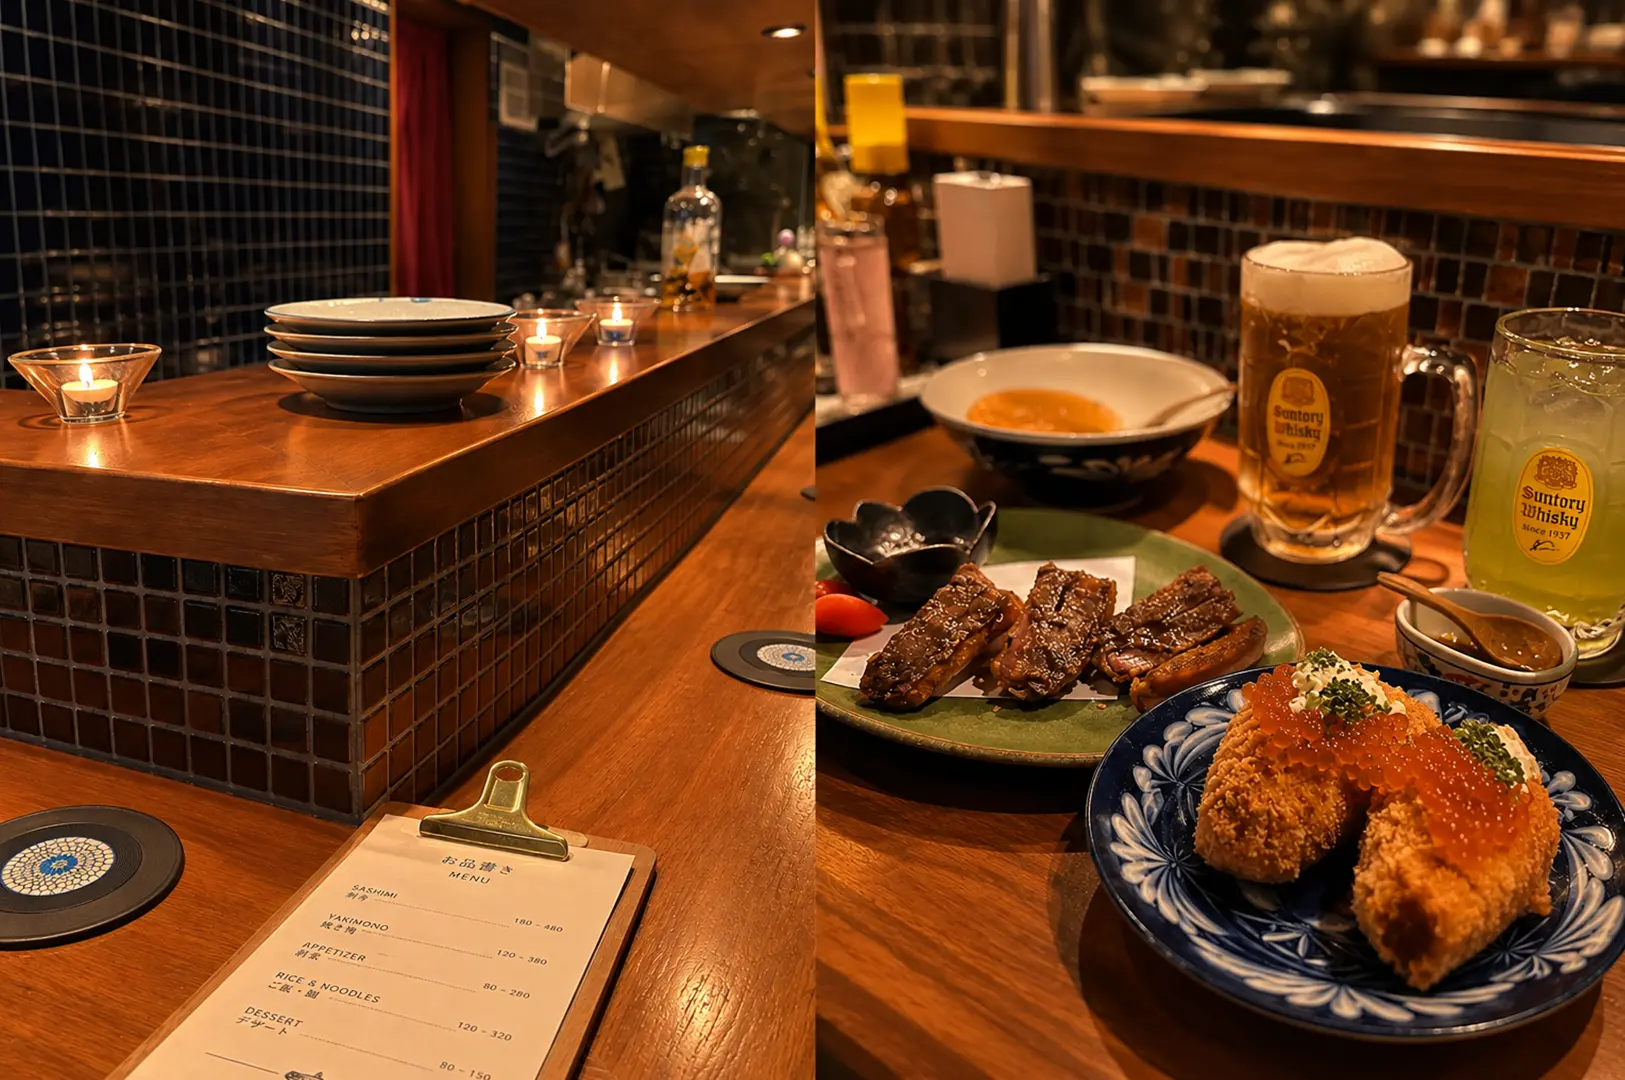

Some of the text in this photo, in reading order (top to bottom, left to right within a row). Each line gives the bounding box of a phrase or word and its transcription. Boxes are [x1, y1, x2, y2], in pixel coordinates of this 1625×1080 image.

[1274, 404, 1324, 426] Suntory
[1274, 420, 1321, 441] Whisky
[1521, 485, 1586, 514] Suntory
[1520, 502, 1579, 531] Whisky
[442, 855, 513, 875] お品書き
[448, 871, 491, 884] MENU
[352, 884, 398, 899] SASHIMI
[328, 913, 389, 932] YAKIMONO
[514, 918, 533, 926] 180
[543, 924, 564, 933] 480
[302, 941, 367, 962] APPETIZER
[496, 949, 516, 959] 120
[527, 956, 548, 966] 380
[275, 971, 381, 1004] RICE & NOODLES
[482, 982, 497, 991] 80
[509, 989, 531, 999] 280
[236, 1015, 288, 1035] デザート
[244, 1006, 303, 1028] DESSERT
[457, 1021, 478, 1033] 120
[490, 1030, 513, 1042] 320
[439, 1061, 455, 1072] 80
[469, 1069, 492, 1080] 150
